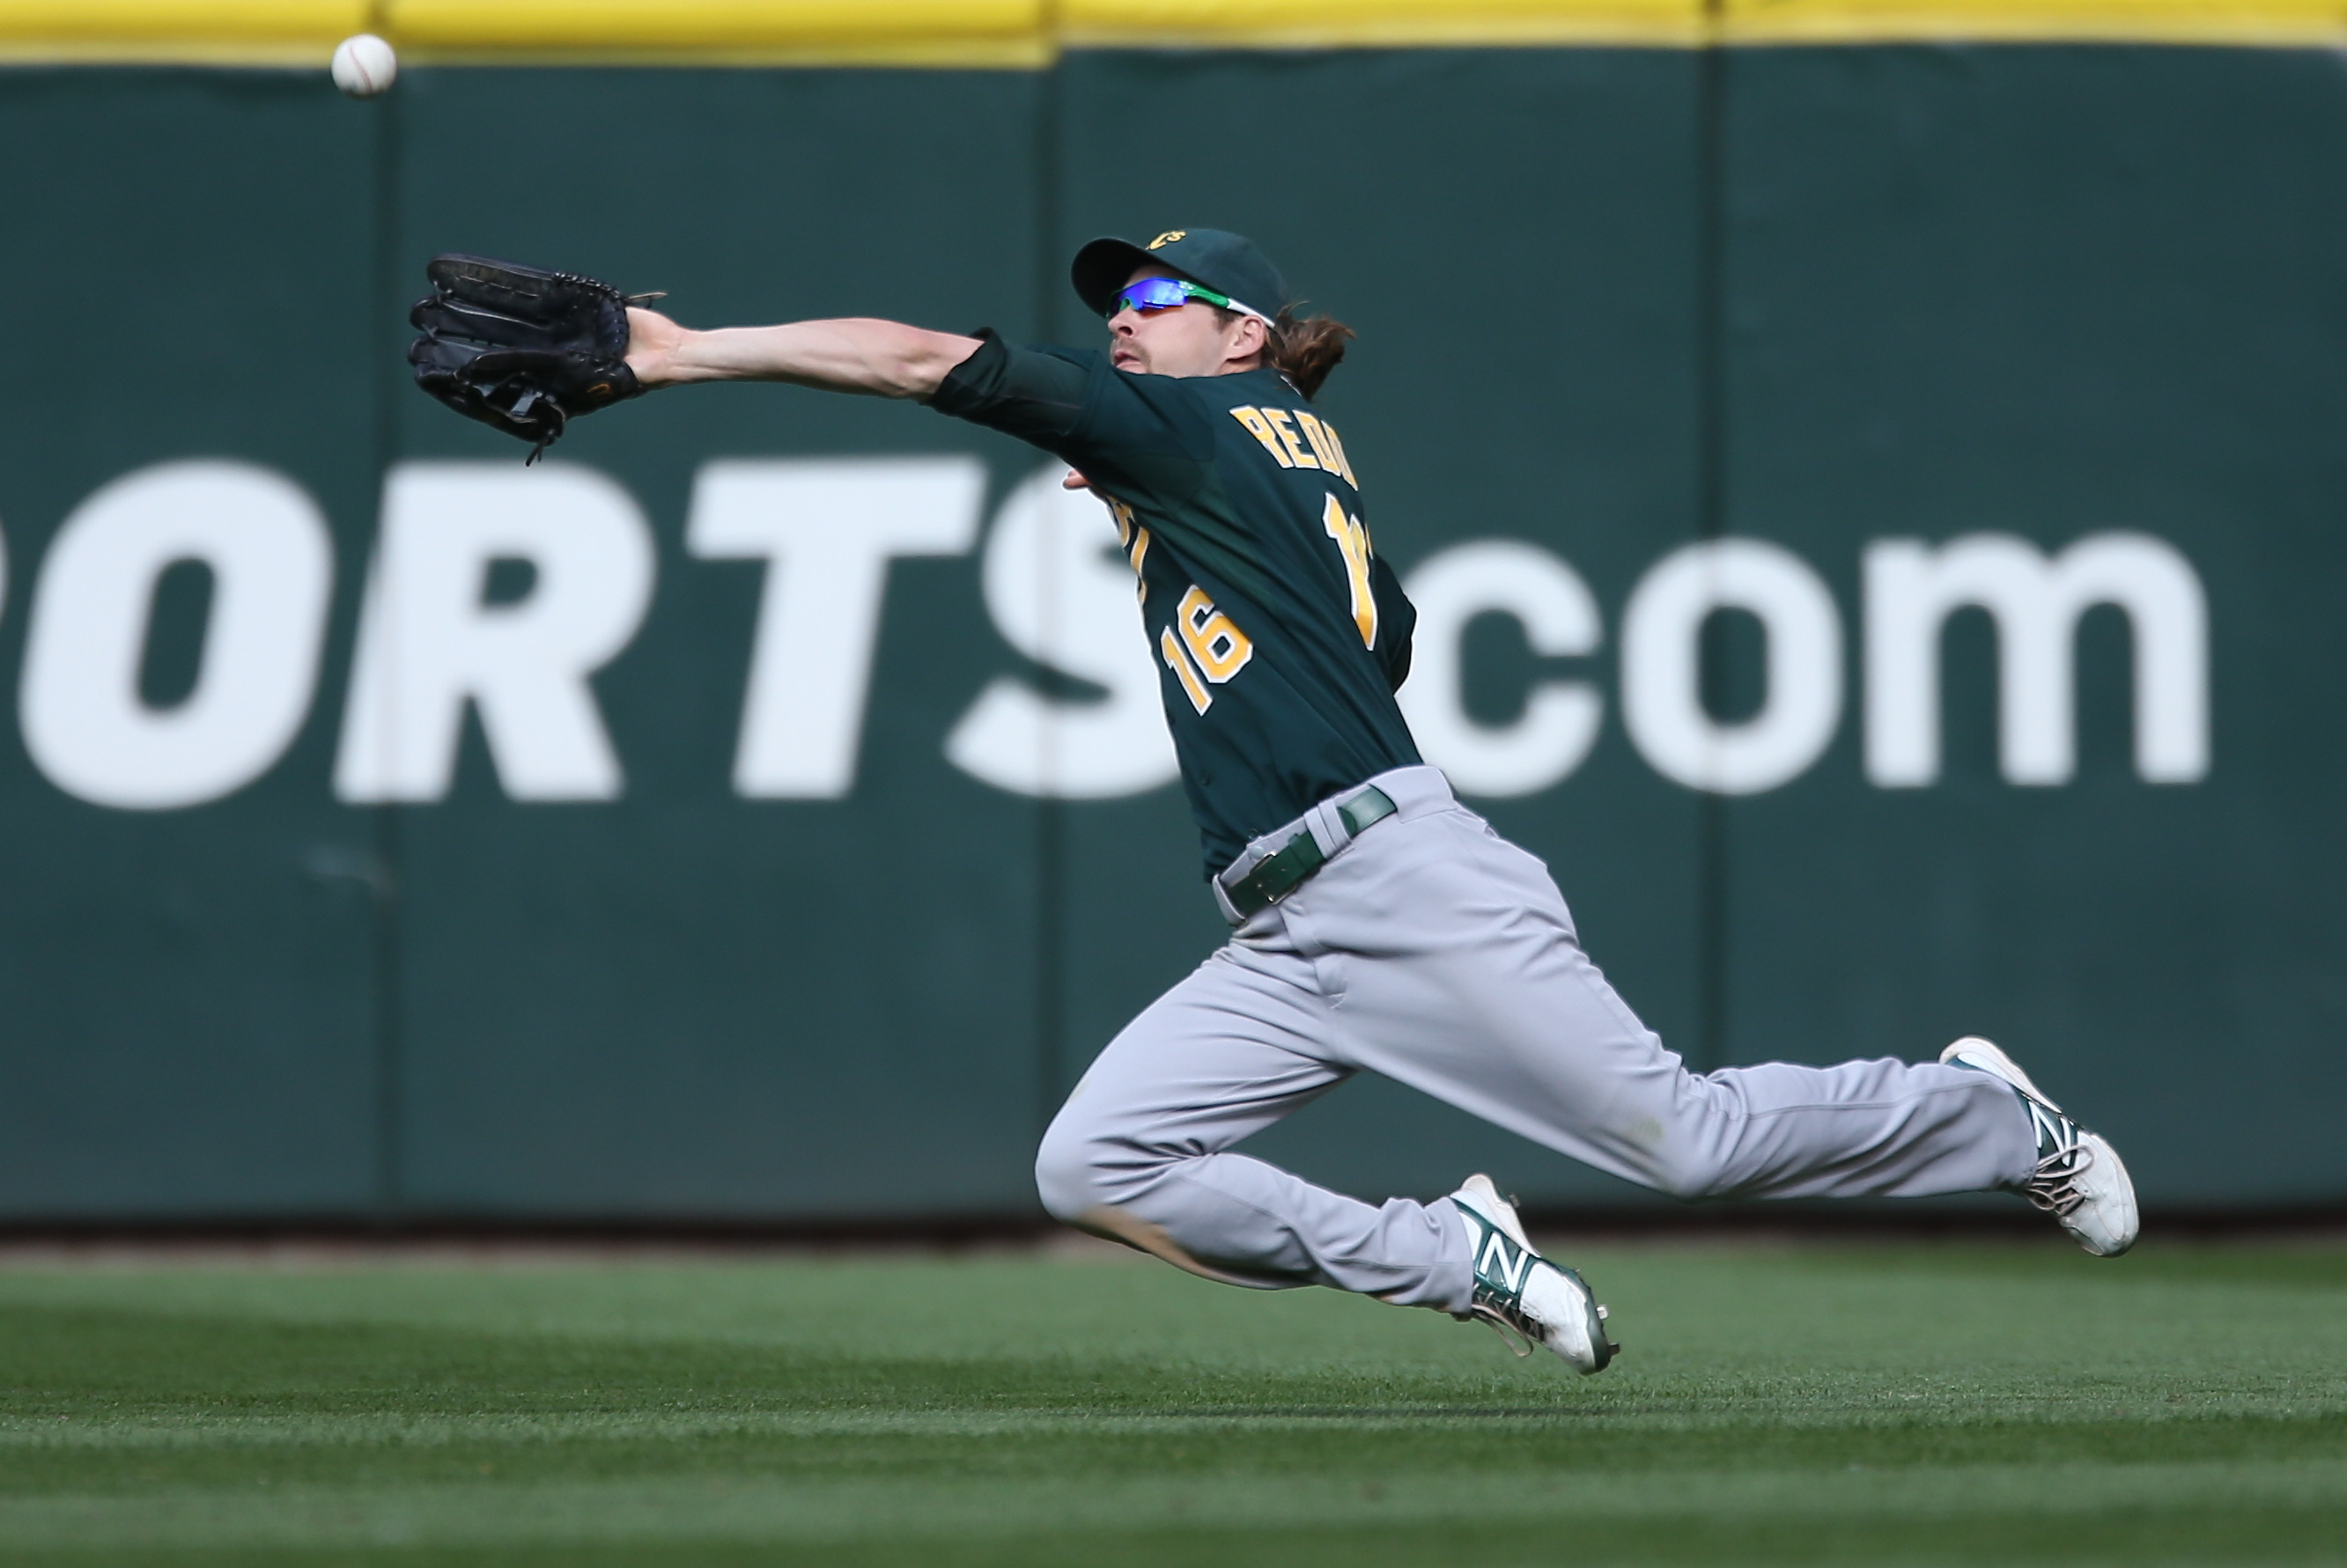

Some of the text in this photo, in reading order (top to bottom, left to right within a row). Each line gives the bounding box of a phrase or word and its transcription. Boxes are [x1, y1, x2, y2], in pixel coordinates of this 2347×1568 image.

[0, 457, 1183, 811] ORTS
[1160, 584, 1254, 717] 16
[1477, 1231, 1530, 1294] N
